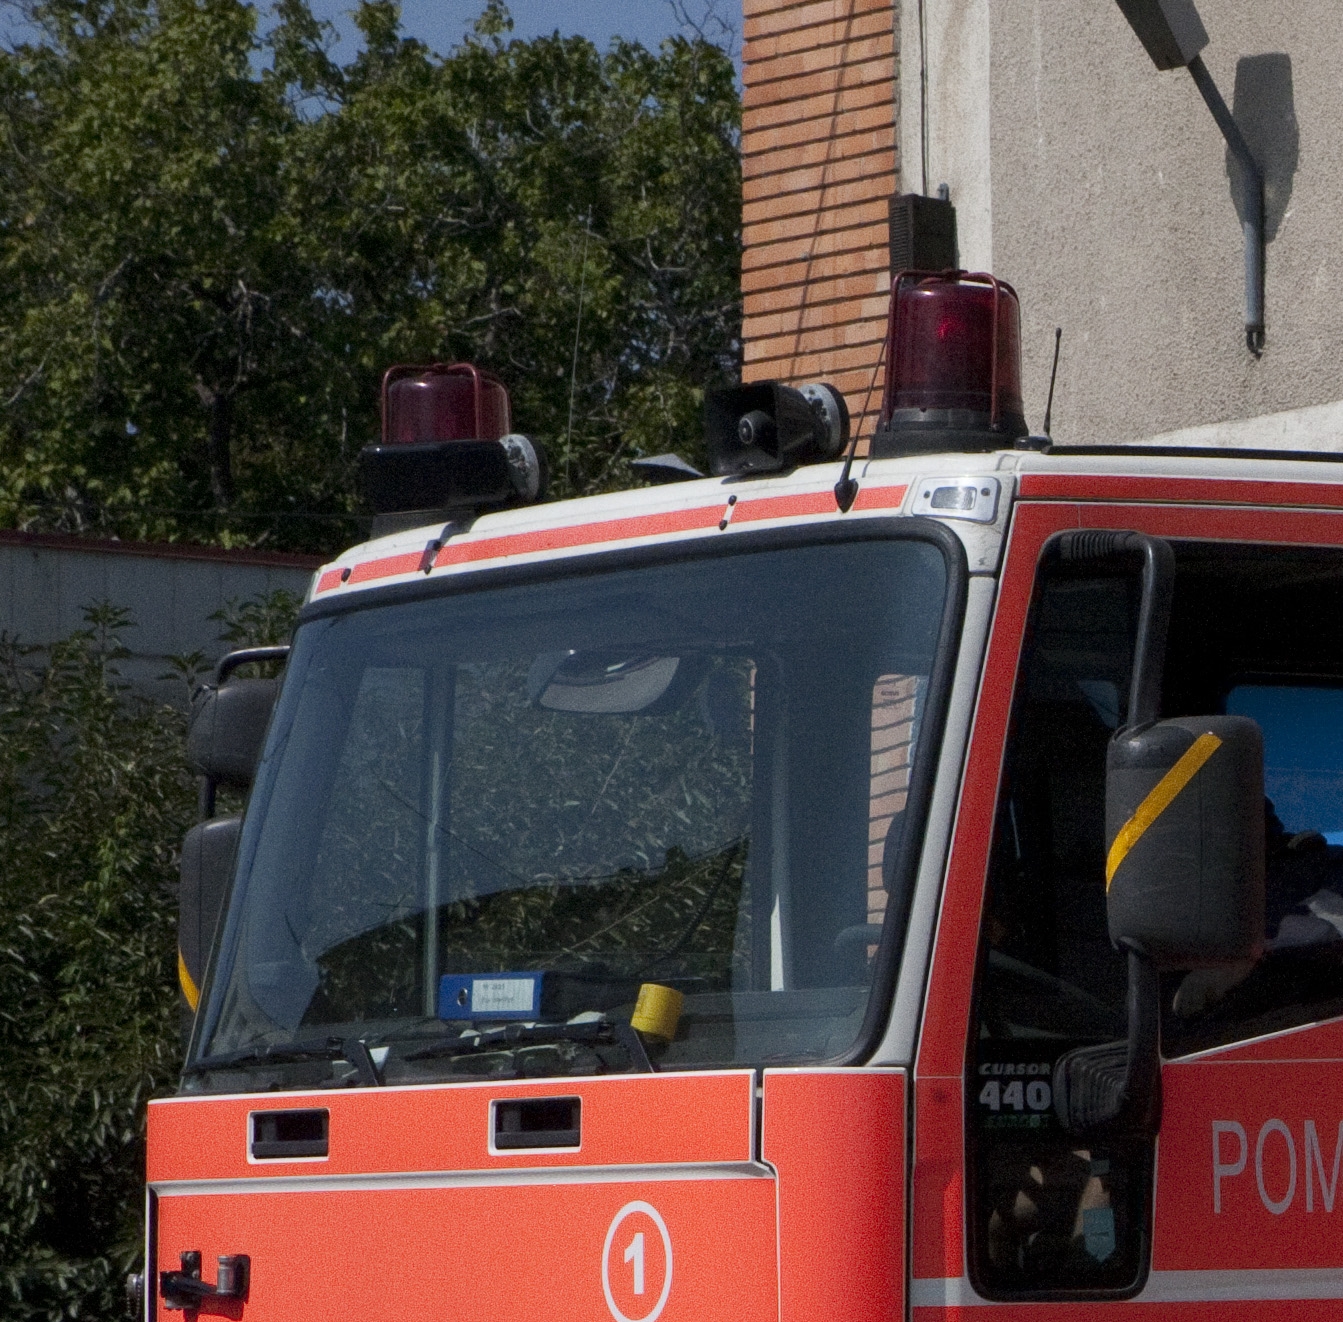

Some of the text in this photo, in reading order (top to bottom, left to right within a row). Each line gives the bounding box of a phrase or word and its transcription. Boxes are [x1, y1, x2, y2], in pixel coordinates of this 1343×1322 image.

[978, 1063, 1051, 1075] CURSOR
[979, 1081, 1052, 1111] 440
[623, 1232, 647, 1295] 1
